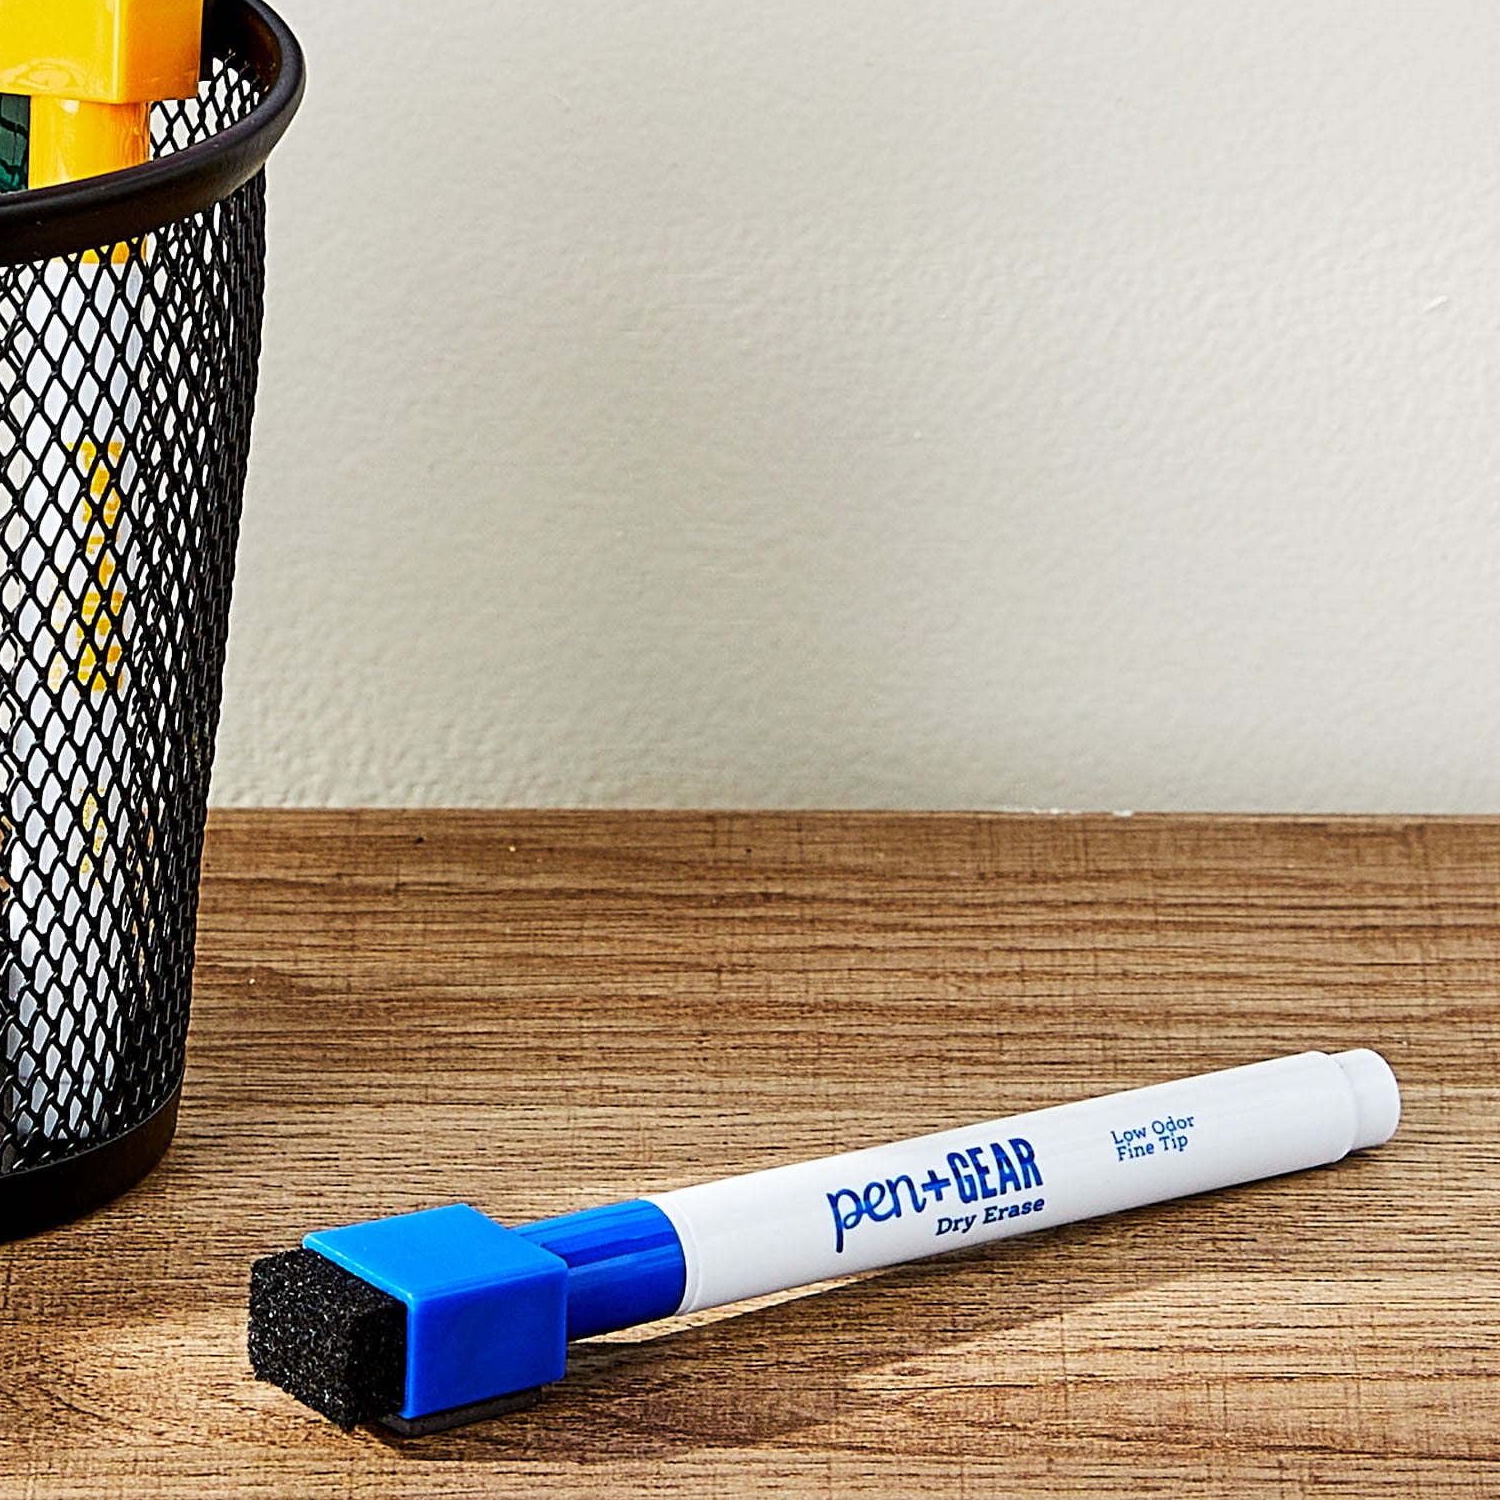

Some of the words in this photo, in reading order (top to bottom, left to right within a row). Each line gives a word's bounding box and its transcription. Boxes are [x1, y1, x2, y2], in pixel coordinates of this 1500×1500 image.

[1110, 1127, 1147, 1148] Low
[1151, 1115, 1195, 1137] Odor
[1116, 1142, 1156, 1162] Fine
[1158, 1134, 1189, 1153] Tip
[826, 1137, 1044, 1252] pen+GEAR
[936, 1208, 977, 1236] Dry
[983, 1198, 1045, 1223] Erase
